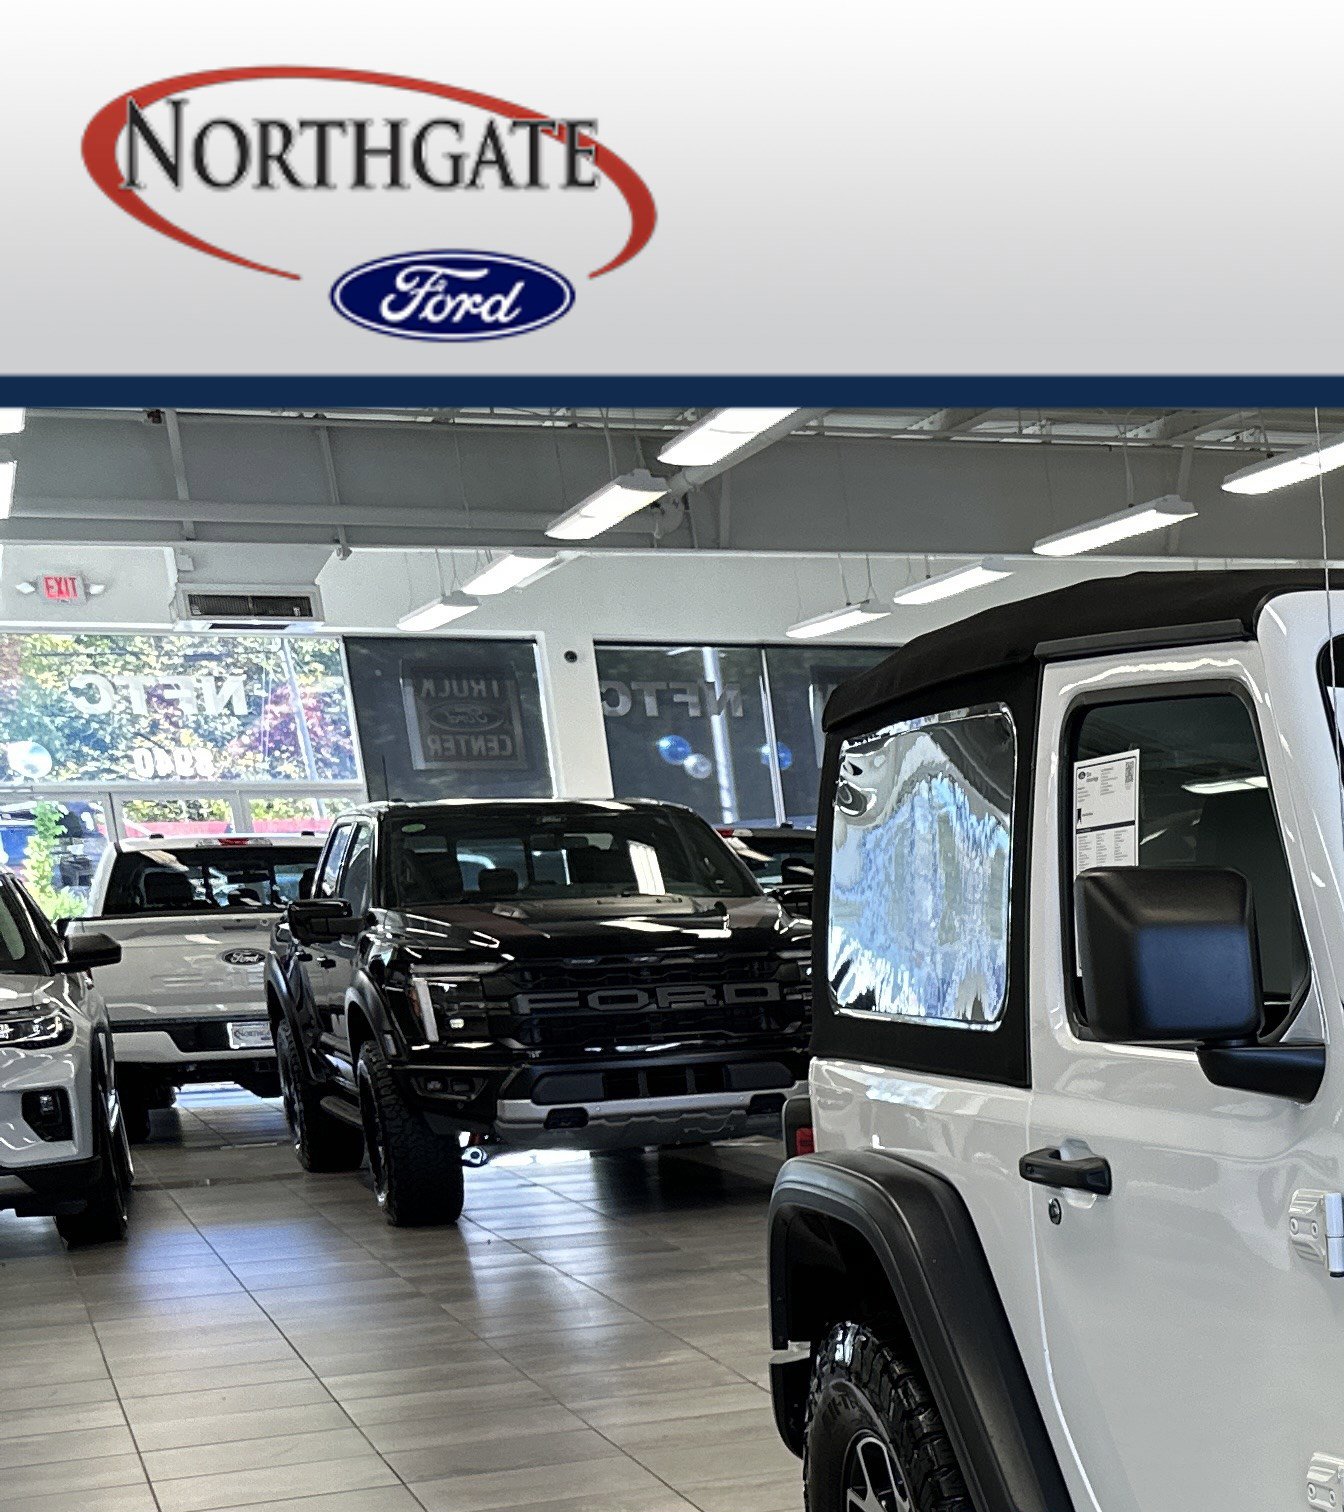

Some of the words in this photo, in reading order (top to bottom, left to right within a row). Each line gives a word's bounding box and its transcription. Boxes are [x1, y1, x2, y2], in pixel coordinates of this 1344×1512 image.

[43, 576, 79, 599] EXIT
[230, 953, 260, 963] Ford
[512, 982, 782, 1016] FORD
